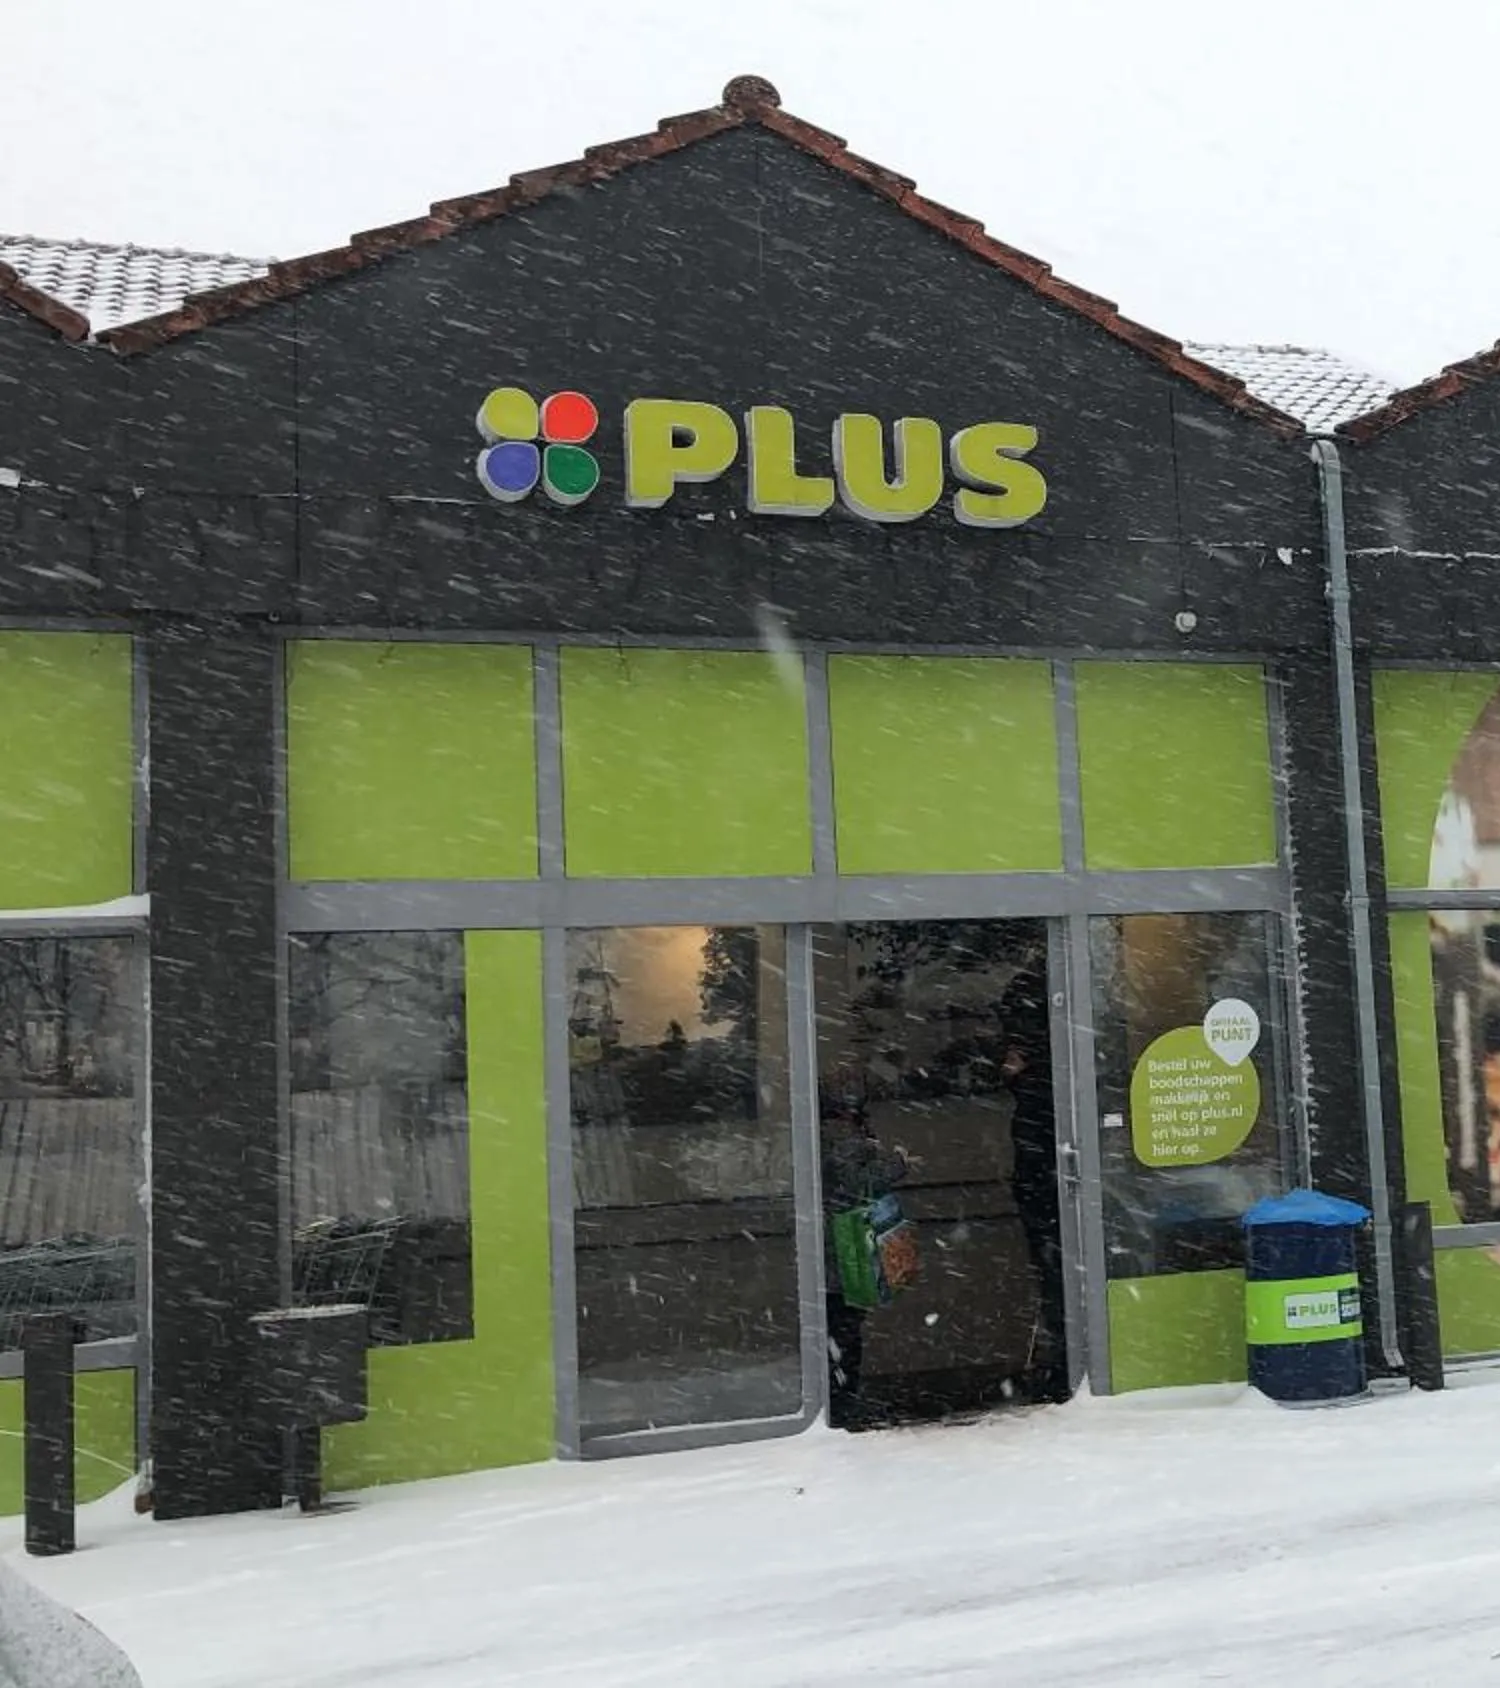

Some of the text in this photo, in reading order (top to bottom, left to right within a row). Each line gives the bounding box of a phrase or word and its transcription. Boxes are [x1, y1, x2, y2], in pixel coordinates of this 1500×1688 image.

[625, 398, 1048, 528] PLUS
[1210, 1027, 1253, 1042] PUNT
[1148, 1058, 1211, 1073] Bestel uw
[1149, 1075, 1243, 1088] boodschappen
[1213, 1091, 1231, 1101] en
[1151, 1103, 1243, 1126] snel op plus.nl
[1151, 1128, 1169, 1140] en
[1171, 1123, 1199, 1138] haal
[1151, 1143, 1178, 1157] hier
[1299, 1302, 1337, 1316] PLUS
